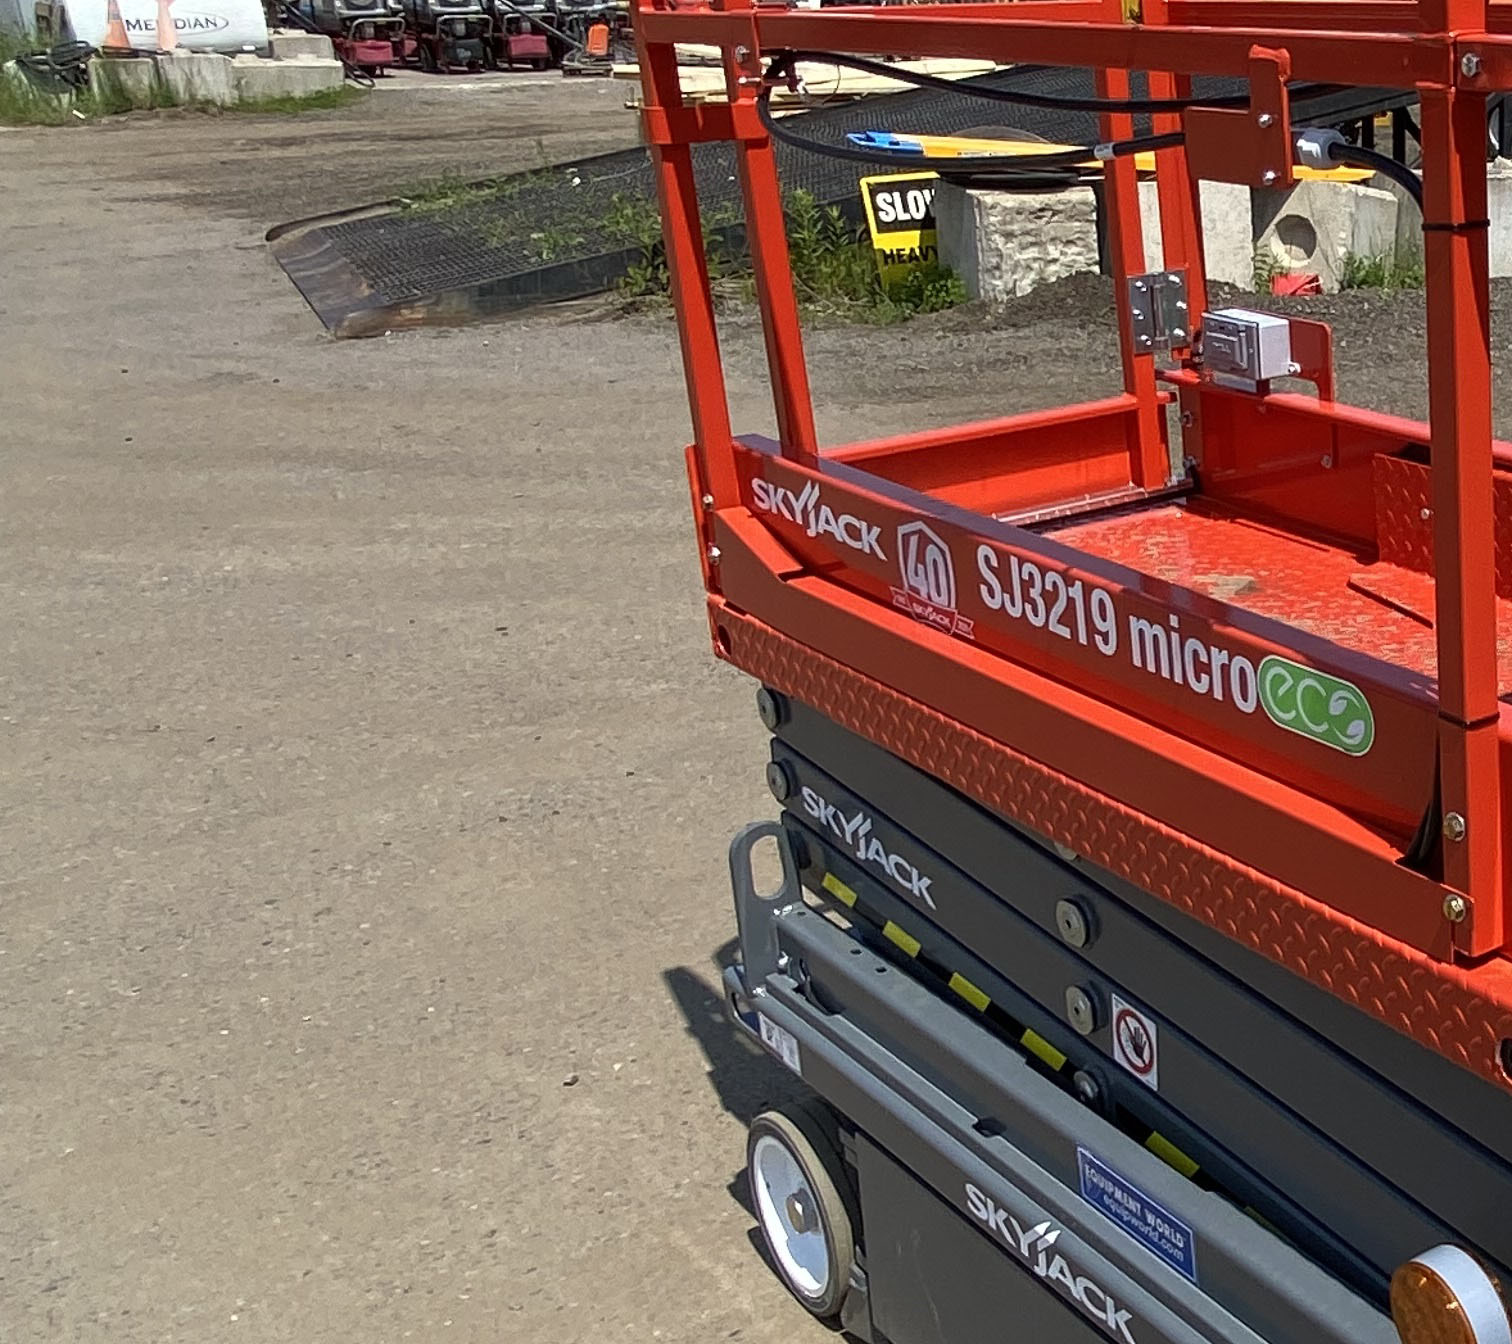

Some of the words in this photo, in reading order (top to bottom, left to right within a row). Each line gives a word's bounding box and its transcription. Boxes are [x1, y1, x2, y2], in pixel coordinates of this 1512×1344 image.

[125, 17, 218, 32] MEDIAN
[751, 477, 888, 562] SKYJACK
[907, 534, 950, 608] 40
[976, 544, 1118, 657] SJ3219
[1129, 613, 1258, 715] micro
[1264, 665, 1366, 746] eco
[802, 786, 937, 911] SKYJACK
[1084, 1164, 1142, 1217] EQUIPMENT
[1144, 1208, 1185, 1248] WORLD
[1103, 1194, 1185, 1262] equipworld.com
